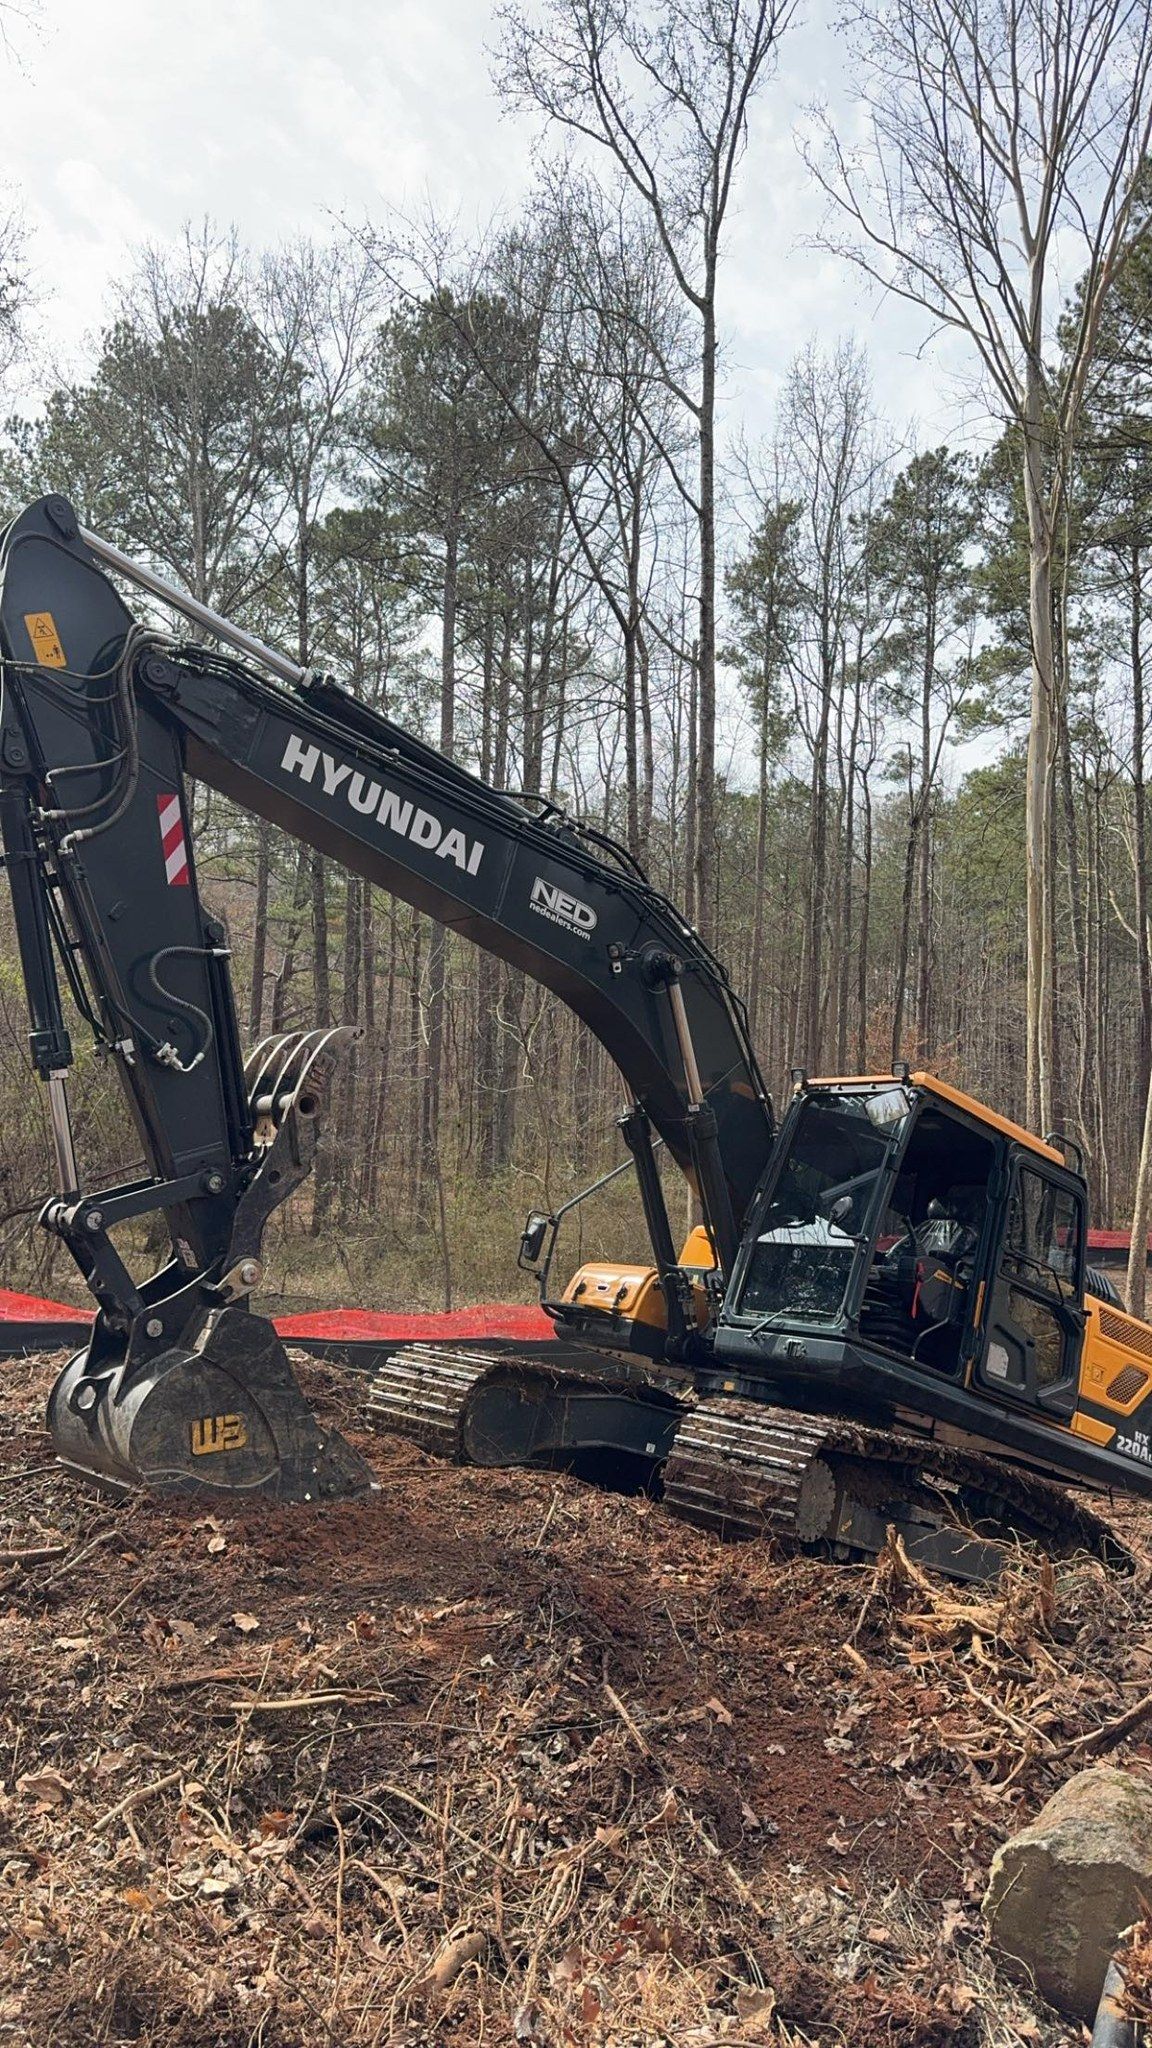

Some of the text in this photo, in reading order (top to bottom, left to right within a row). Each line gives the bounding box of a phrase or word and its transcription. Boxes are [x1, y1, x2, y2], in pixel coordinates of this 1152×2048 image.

[281, 734, 485, 876] HYUNDAI
[529, 902, 591, 941] nedealers.com
[530, 876, 598, 930] NED
[1134, 1431, 1149, 1446] HX
